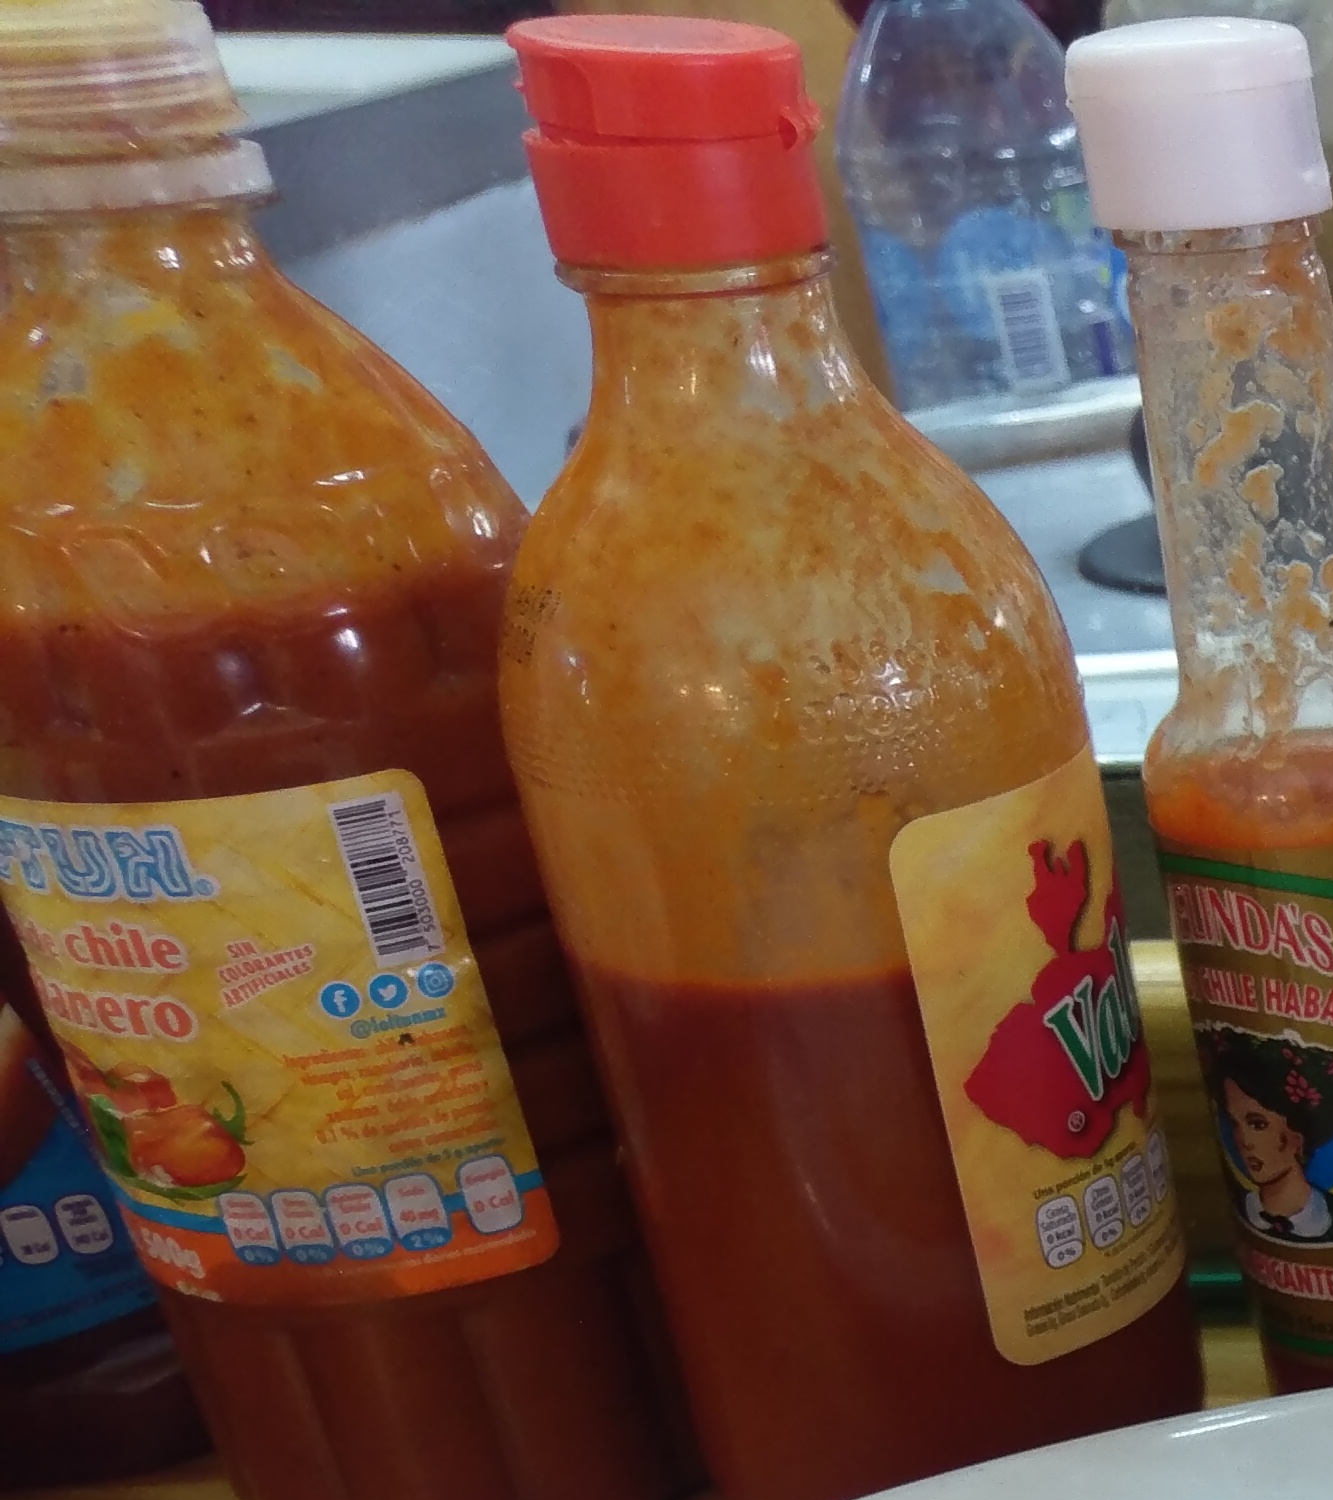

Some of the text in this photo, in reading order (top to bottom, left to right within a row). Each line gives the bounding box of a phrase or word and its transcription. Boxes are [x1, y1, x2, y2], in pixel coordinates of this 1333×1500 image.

[0, 819, 196, 898] TUN
[63, 922, 185, 970] chile
[219, 945, 313, 983] COLORANTES
[226, 941, 257, 959] SIN
[32, 970, 194, 1038] anero
[222, 961, 311, 1008] ARTIFICIALES
